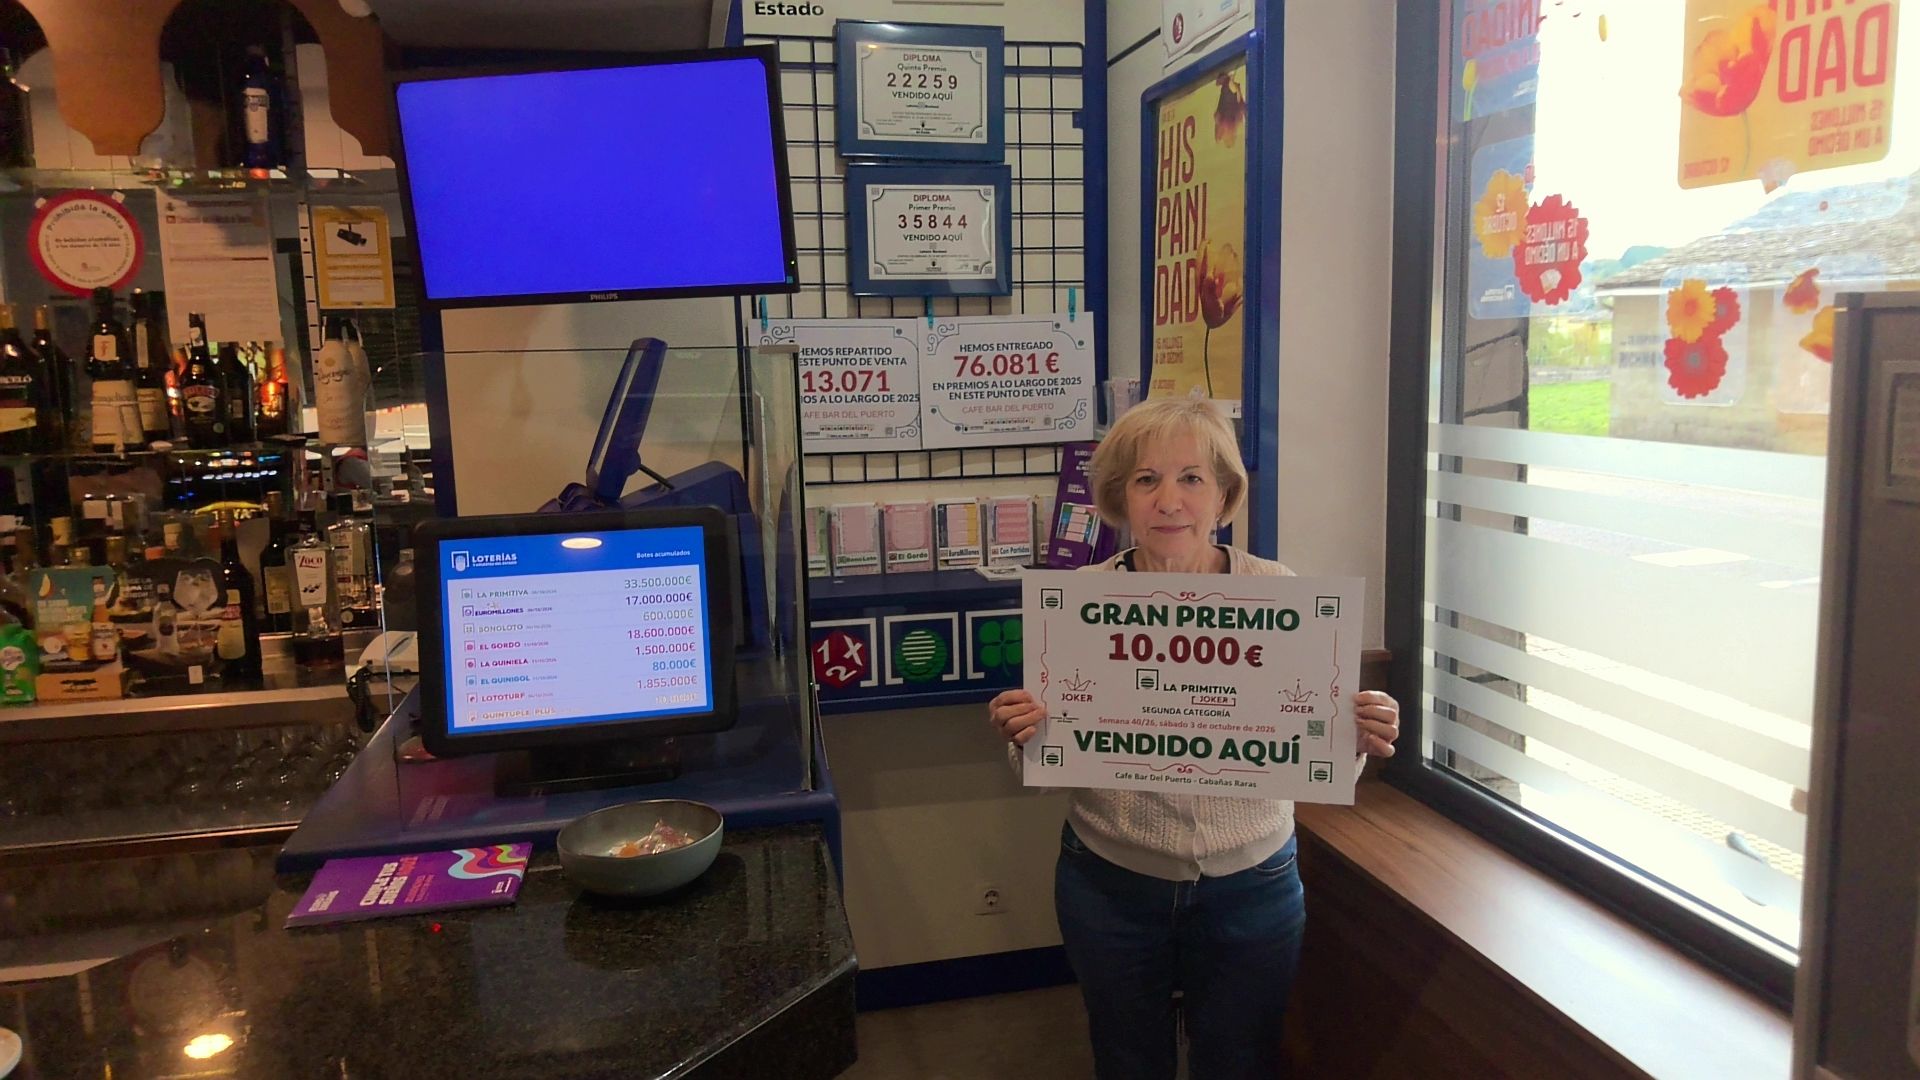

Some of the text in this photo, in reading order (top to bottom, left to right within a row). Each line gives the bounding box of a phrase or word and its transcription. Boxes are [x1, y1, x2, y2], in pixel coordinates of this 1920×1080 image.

[754, 1, 824, 16] Estado
[903, 53, 942, 62] DIPLOMA
[897, 63, 921, 71] Quinto
[892, 91, 953, 101] VENDIDO AQUÍ
[1159, 115, 1196, 192] HIS
[913, 194, 951, 202] DIPLOMA
[1157, 182, 1207, 259] PANI
[942, 233, 963, 242] AQUÍ
[1156, 258, 1200, 326] DAD
[800, 347, 893, 356] HEMOS REPARTIDO
[959, 341, 1053, 353] HEMOS ENTREGADO
[822, 357, 857, 366] PUNTO
[859, 357, 872, 366] DE
[874, 357, 907, 366] VENTA
[954, 353, 1040, 378] 76.081
[801, 370, 891, 393] 13.071
[932, 377, 1082, 391] EN PREMIOS A LO LARGO DE 2025
[819, 395, 828, 404] A
[829, 395, 843, 403] LO
[844, 394, 881, 403] LARGO
[882, 394, 895, 403] DE
[897, 393, 920, 403] 2025
[949, 387, 1066, 400] EN ESTE PUNTO DE VENTA
[962, 402, 1054, 414] CAFE BAR DEL PUERTO
[803, 411, 820, 419] AFE
[822, 411, 840, 419] BAR
[860, 410, 895, 418] PUERTO
[472, 553, 517, 563] LOTERÍAS
[654, 550, 691, 558] acumulados
[949, 548, 980, 557] EuroMillones
[624, 575, 692, 589] 33.500.000€
[489, 590, 528, 598] PRIMITIVA
[625, 592, 693, 606] 17.000.000€
[475, 608, 524, 616] EUROMILLONES
[643, 608, 694, 621] 600.000€
[1080, 602, 1300, 631] GRAN PREMIO
[627, 625, 695, 639] 18.600.000€
[491, 641, 521, 649] GORDO
[635, 642, 696, 656] 1.500.000€
[817, 634, 863, 666] 1 X
[492, 659, 528, 667] QUINIELA
[652, 658, 697, 672] 80.000€
[491, 675, 530, 684] QUINIGOL
[825, 665, 857, 682] 2
[637, 675, 697, 689] 1.855.000€
[1163, 683, 1237, 694] LA PRIMITIVA
[481, 693, 525, 702] LOTOTURF
[1061, 693, 1093, 702] JOKER
[1200, 695, 1228, 704] JOKER
[482, 707, 556, 719] QUINTUPLE PLUS
[1142, 706, 1231, 717] SEGUNDA CATEGORÍA
[1280, 704, 1315, 714] JOKER
[1099, 717, 1129, 725] Semana
[1159, 719, 1188, 728] sábado
[1209, 723, 1241, 731] octubre
[1073, 730, 1301, 767] VENDIDO AQUÍ
[1115, 772, 1132, 780] Cafe
[1134, 772, 1148, 780] Bar
[1150, 773, 1163, 782] Del
[1165, 775, 1192, 784] Puerto
[1198, 777, 1233, 787] Cabañas
[1234, 779, 1257, 788] Raras
